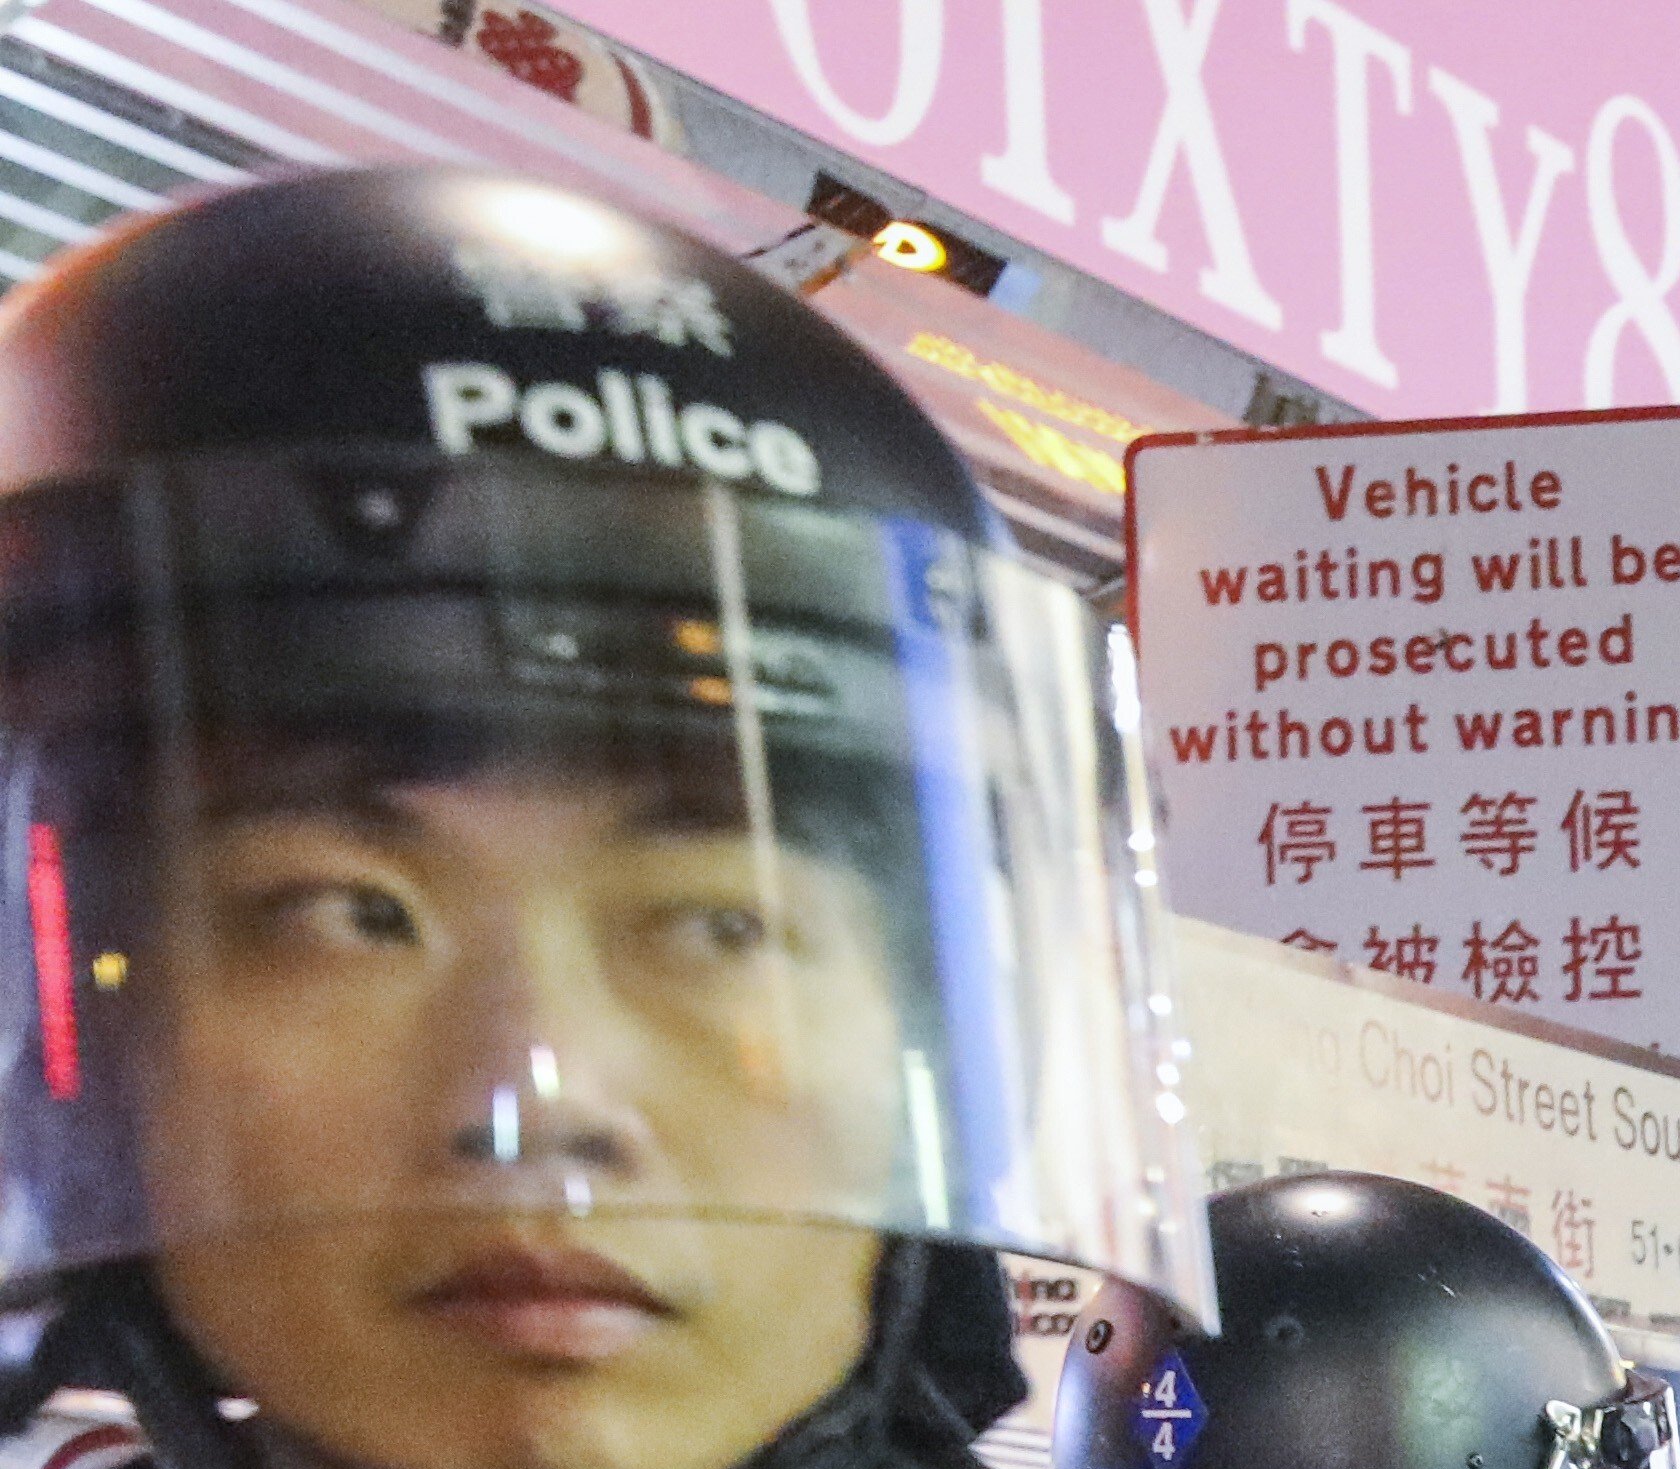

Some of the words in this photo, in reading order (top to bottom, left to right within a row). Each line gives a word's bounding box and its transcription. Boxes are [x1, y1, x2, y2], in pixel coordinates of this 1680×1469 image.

[421, 360, 822, 496] Police
[1314, 462, 1563, 522] Vehicle
[1200, 551, 1445, 607] waiting
[1471, 536, 1588, 593] will
[1253, 614, 1636, 688] prosecuted
[1170, 703, 1428, 764] without
[1258, 790, 1643, 886] 停車等候
[1359, 1018, 1455, 1108] Choi
[1474, 1049, 1599, 1143] Street
